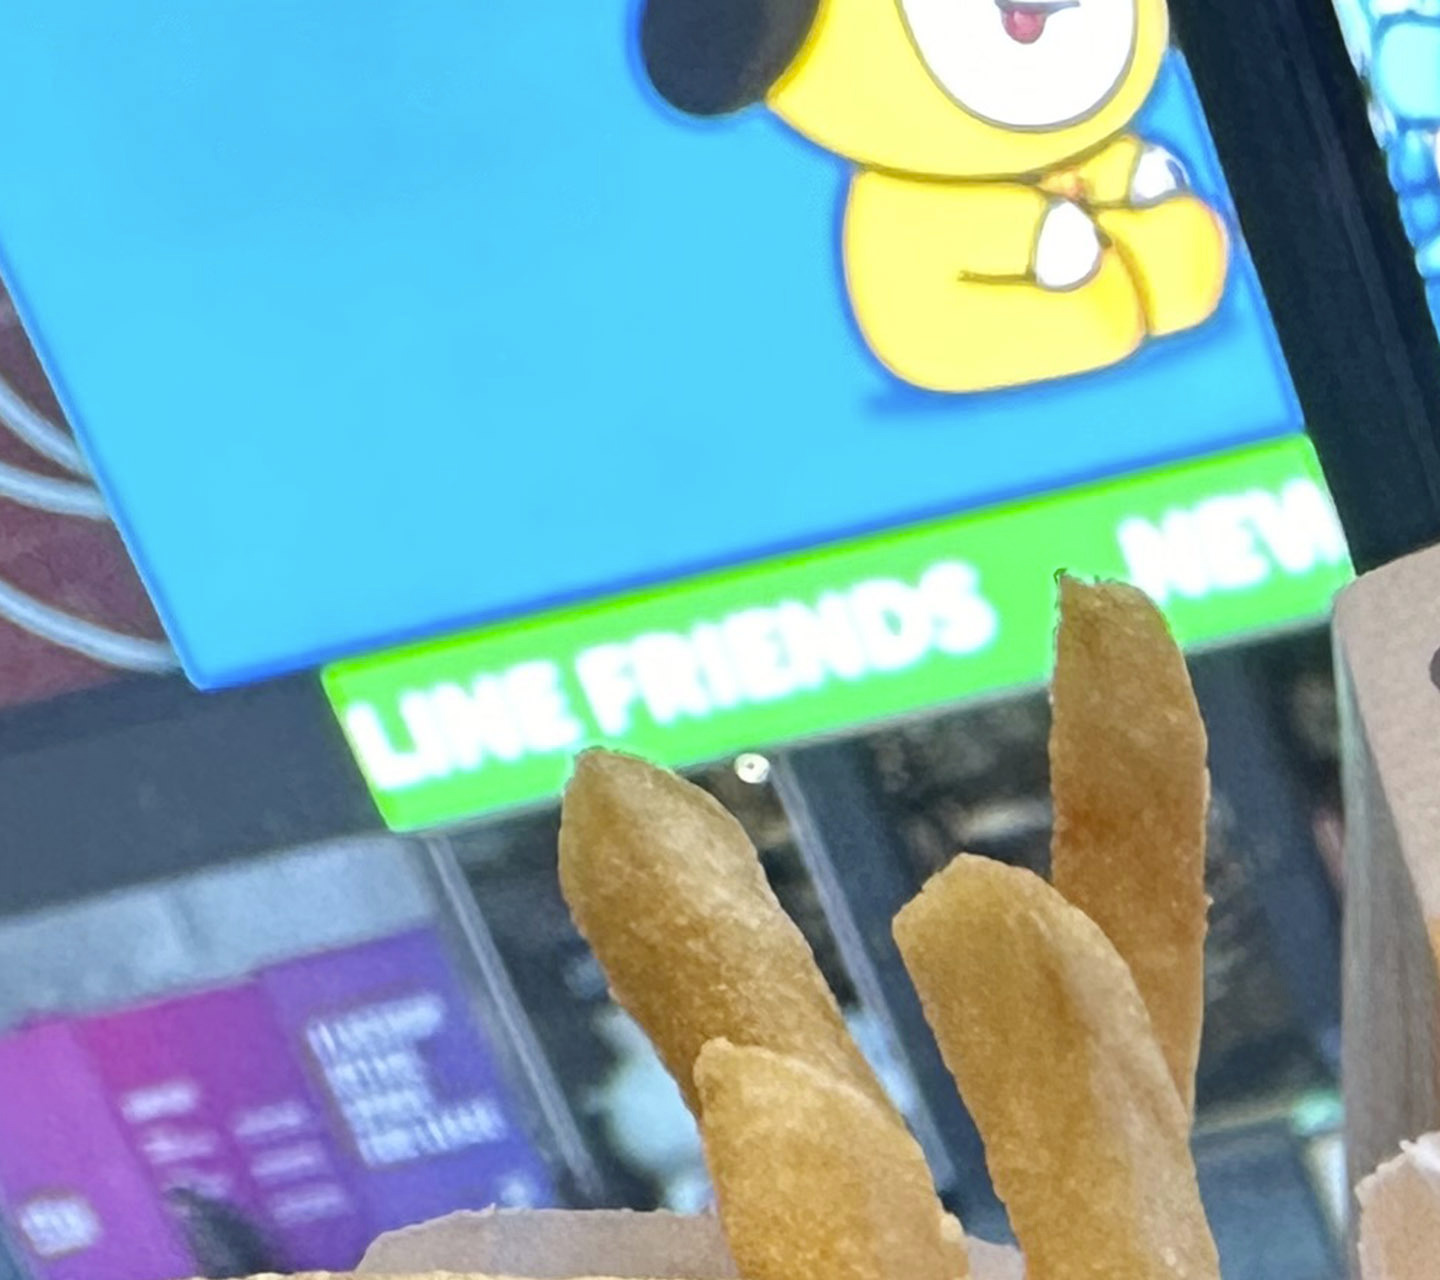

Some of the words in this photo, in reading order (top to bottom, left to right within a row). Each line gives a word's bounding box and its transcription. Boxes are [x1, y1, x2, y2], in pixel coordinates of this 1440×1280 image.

[346, 660, 582, 790] LINE
[574, 561, 997, 736] FRIENDS
[1117, 477, 1348, 606] NEW
